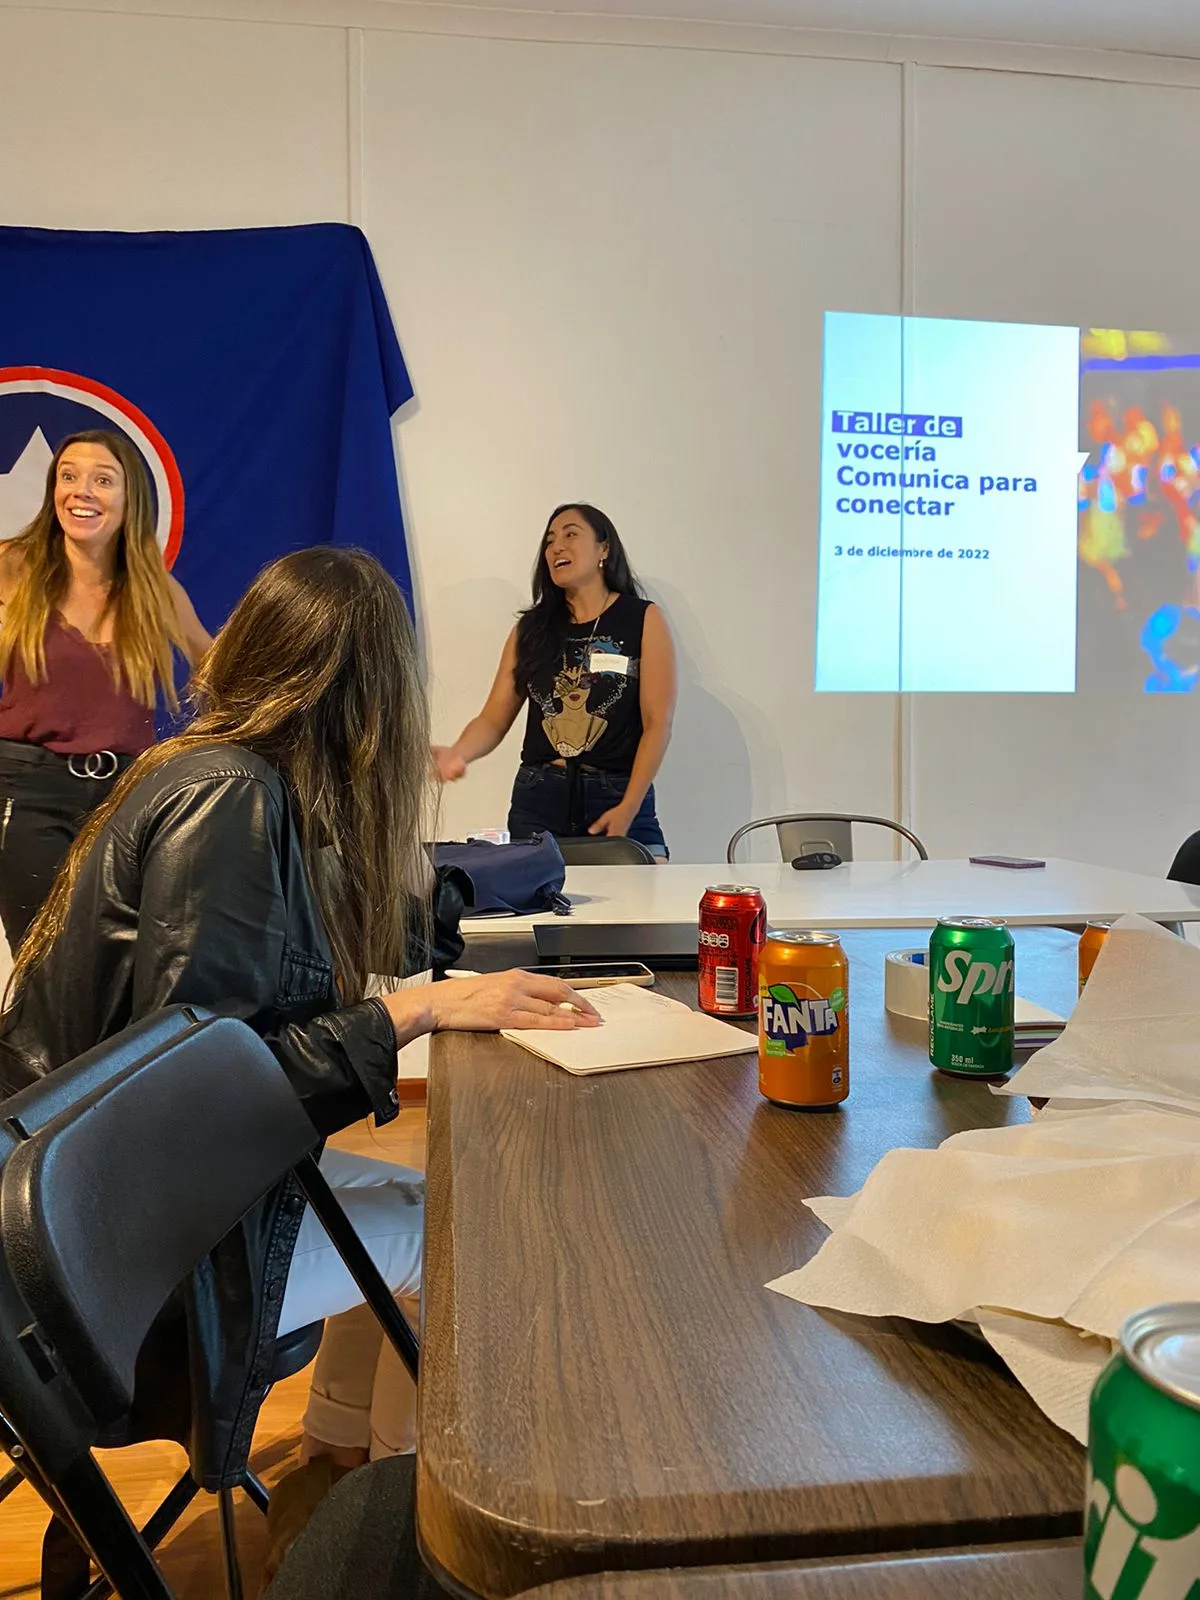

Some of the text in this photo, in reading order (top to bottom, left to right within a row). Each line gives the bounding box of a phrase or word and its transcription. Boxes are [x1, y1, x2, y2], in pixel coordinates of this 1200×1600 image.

[837, 411, 957, 436] Taller de
[836, 440, 937, 462] vocería
[836, 465, 1038, 495] Comunica para
[835, 496, 955, 516] conectar
[834, 546, 990, 560] 3 de diciembre de 2022
[762, 998, 838, 1034] FANTA
